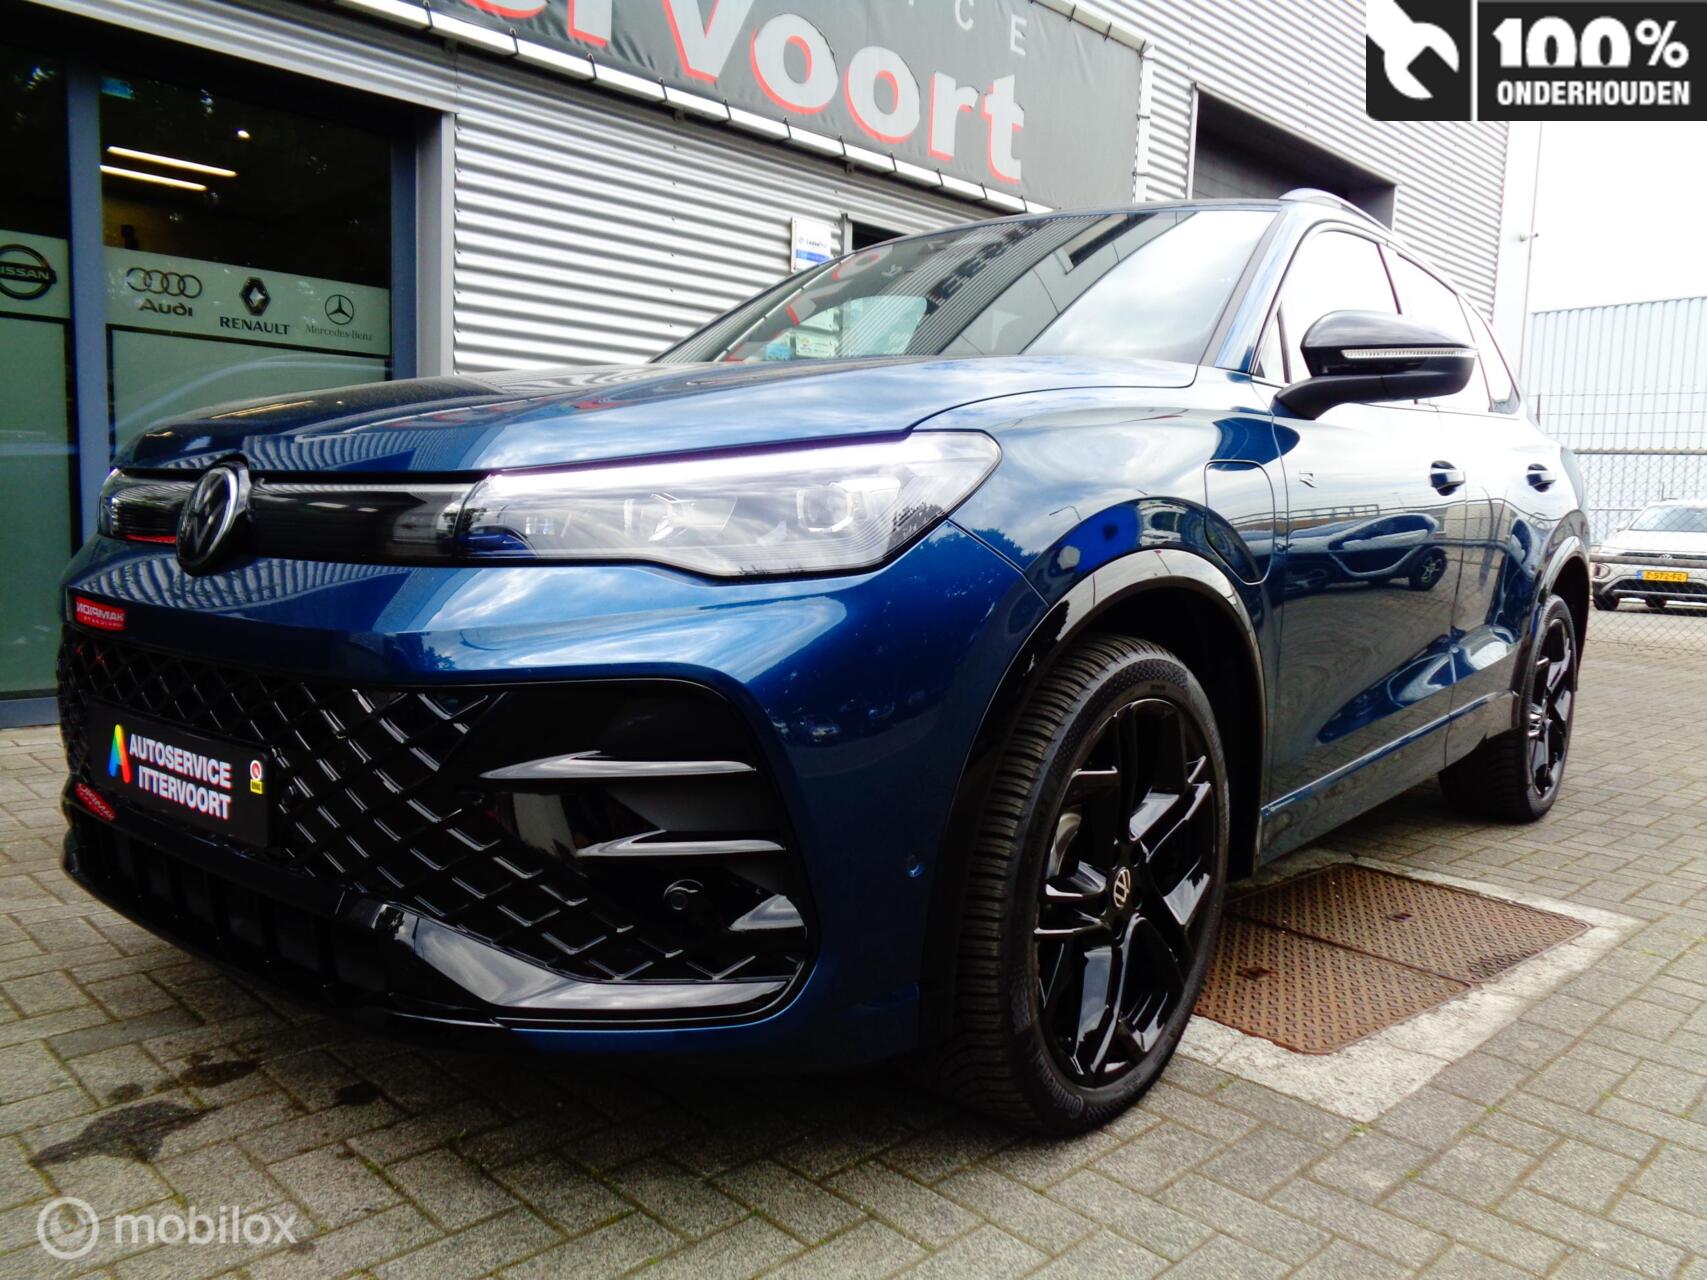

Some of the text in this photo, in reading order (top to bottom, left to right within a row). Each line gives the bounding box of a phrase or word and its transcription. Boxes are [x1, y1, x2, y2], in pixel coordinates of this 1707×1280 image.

[0, 265, 50, 281] ISSAN
[138, 298, 194, 318] Audi
[219, 315, 291, 336] RENAULT
[305, 323, 373, 342] Mercedes-Benz
[129, 733, 233, 789] AUTOSERVICE
[138, 765, 233, 820] ITTERVOORT
